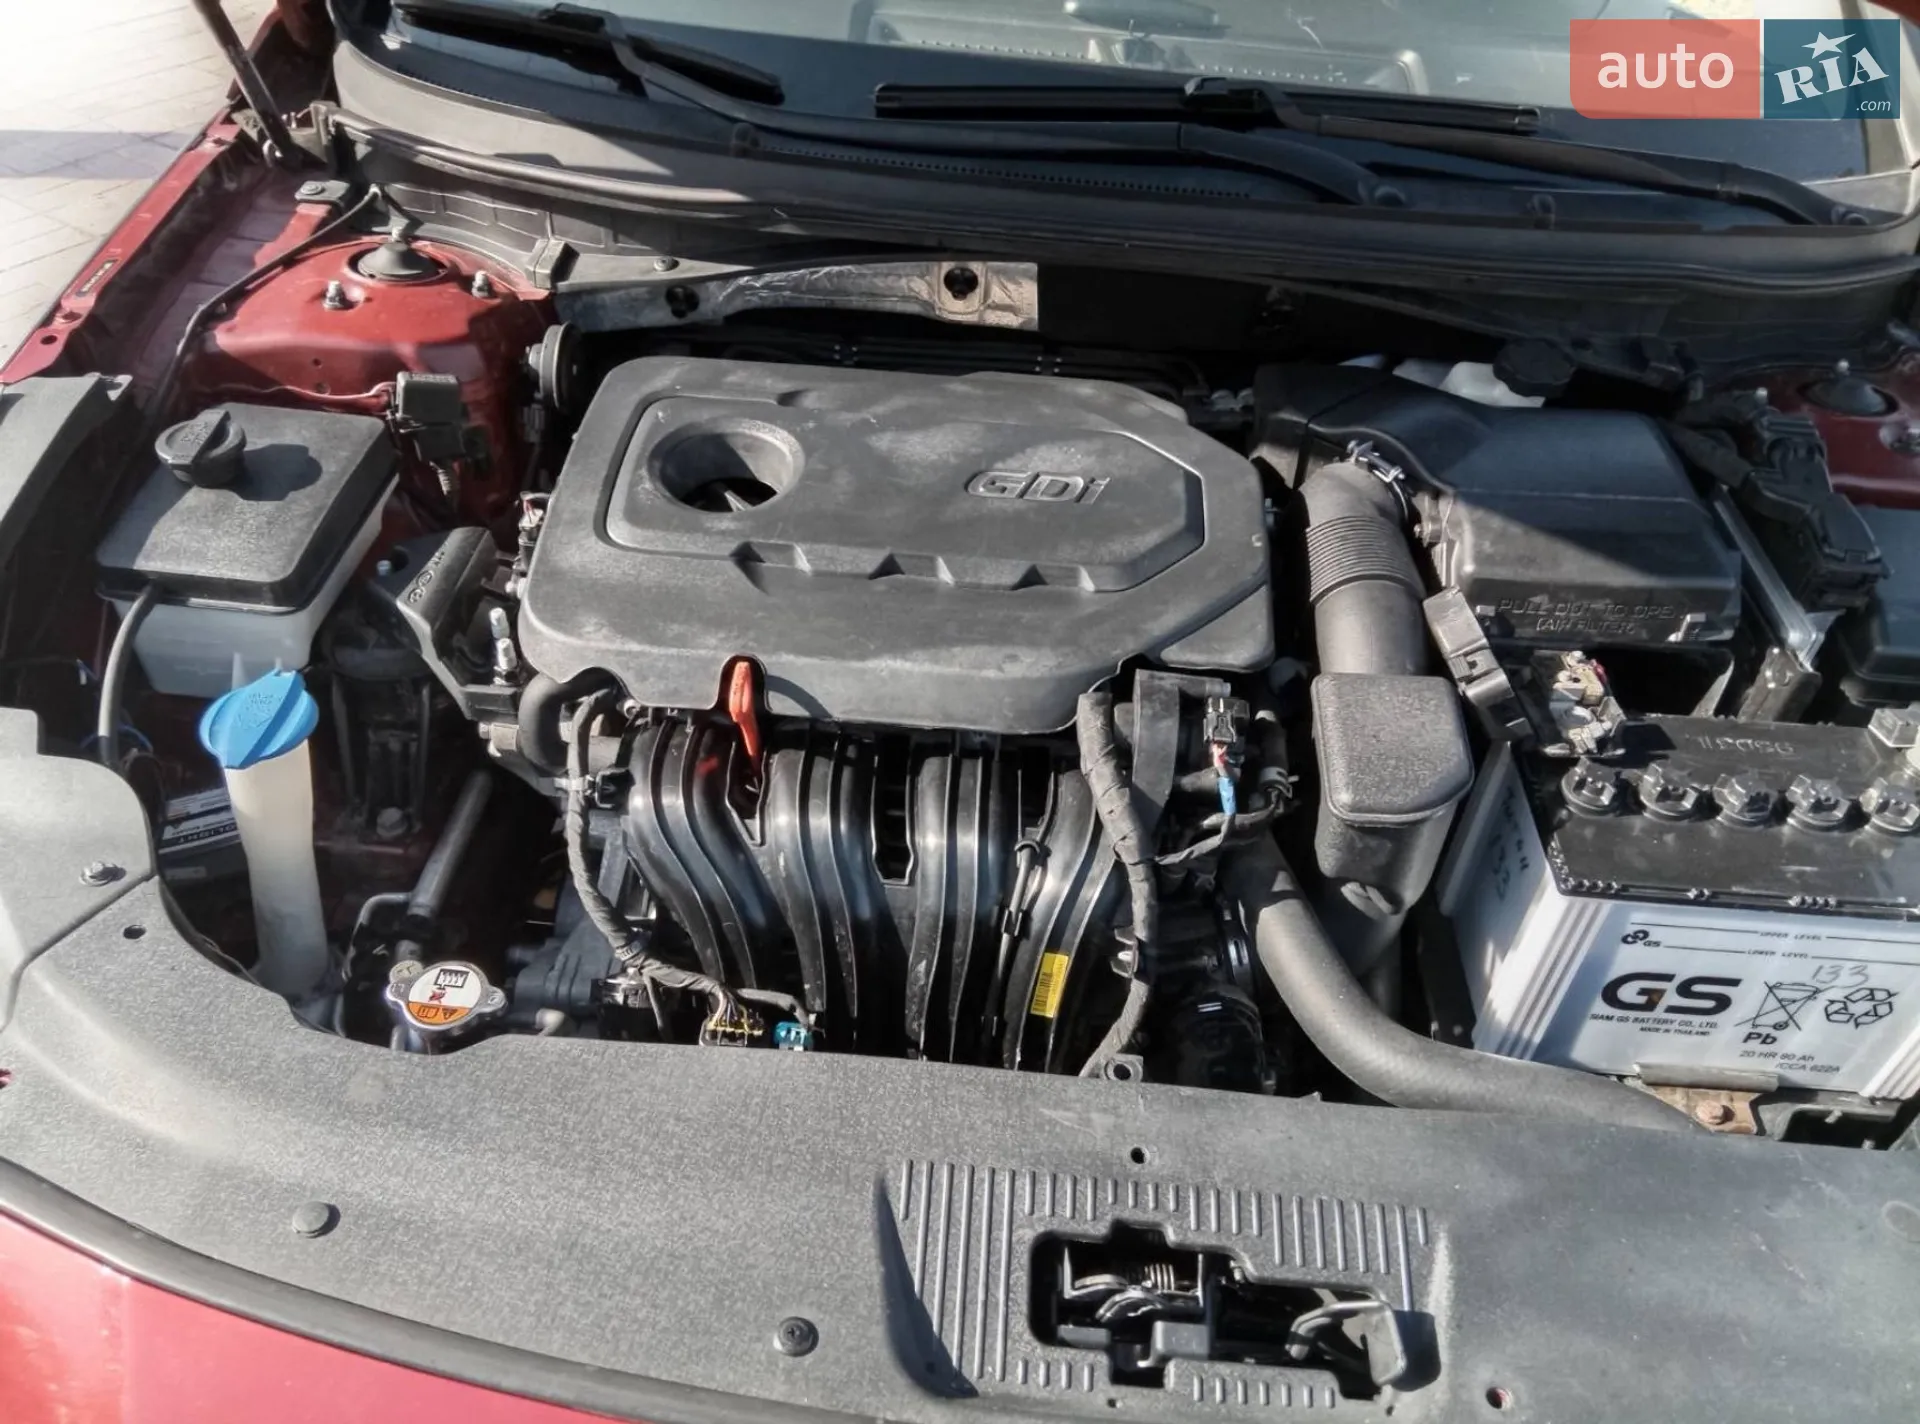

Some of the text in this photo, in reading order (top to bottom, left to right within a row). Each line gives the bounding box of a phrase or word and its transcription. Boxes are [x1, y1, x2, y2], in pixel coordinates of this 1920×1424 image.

[1600, 971, 1743, 1017] GS
[1631, 1016, 1677, 1026] BATTERY
[1742, 1032, 1778, 1045] Pb
[1739, 1050, 1756, 1058] 20
[1757, 1051, 1777, 1060] HR
